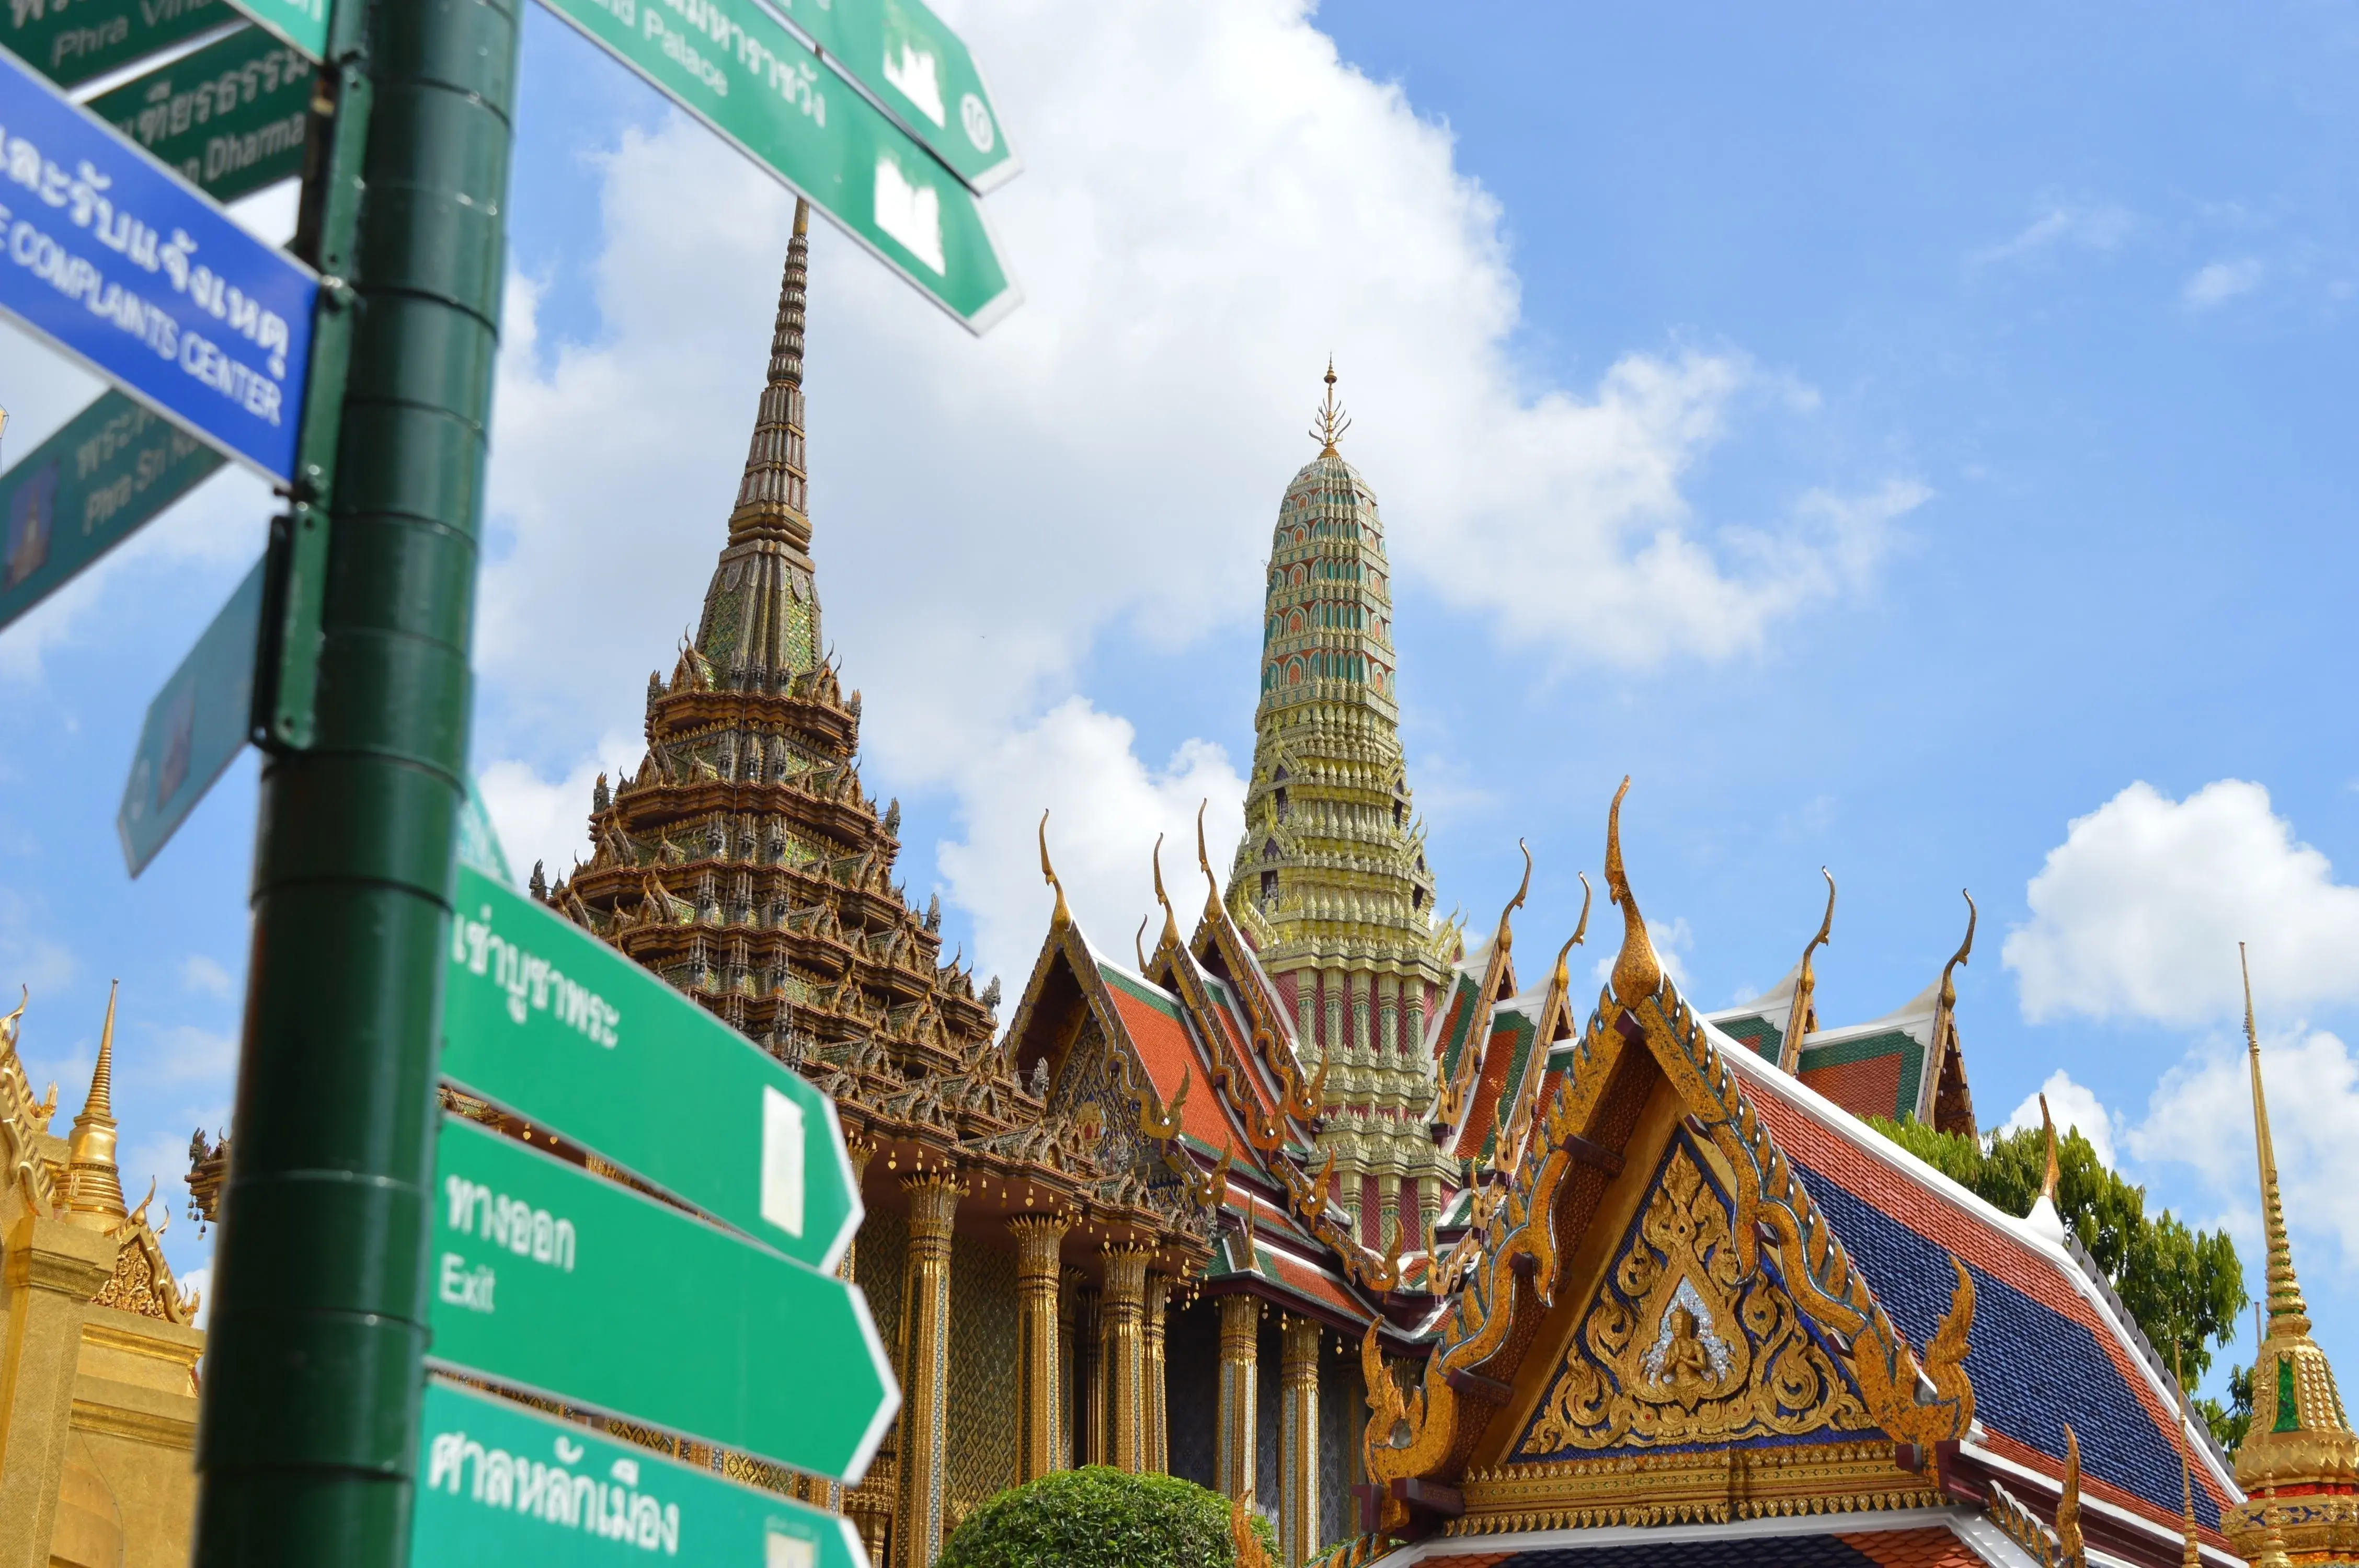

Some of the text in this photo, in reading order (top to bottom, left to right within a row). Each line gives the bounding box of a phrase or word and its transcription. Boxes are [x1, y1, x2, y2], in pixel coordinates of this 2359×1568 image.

[51, 15, 130, 69] Phra
[643, 6, 728, 97] Palace
[205, 111, 306, 182] Dharma
[179, 330, 282, 426] CENTER
[451, 904, 620, 1050] เช่าบูชาพระ
[445, 1174, 576, 1272] ทางออก
[438, 1252, 496, 1313] Exit
[427, 1431, 680, 1555] ศาลหลักเมือง
